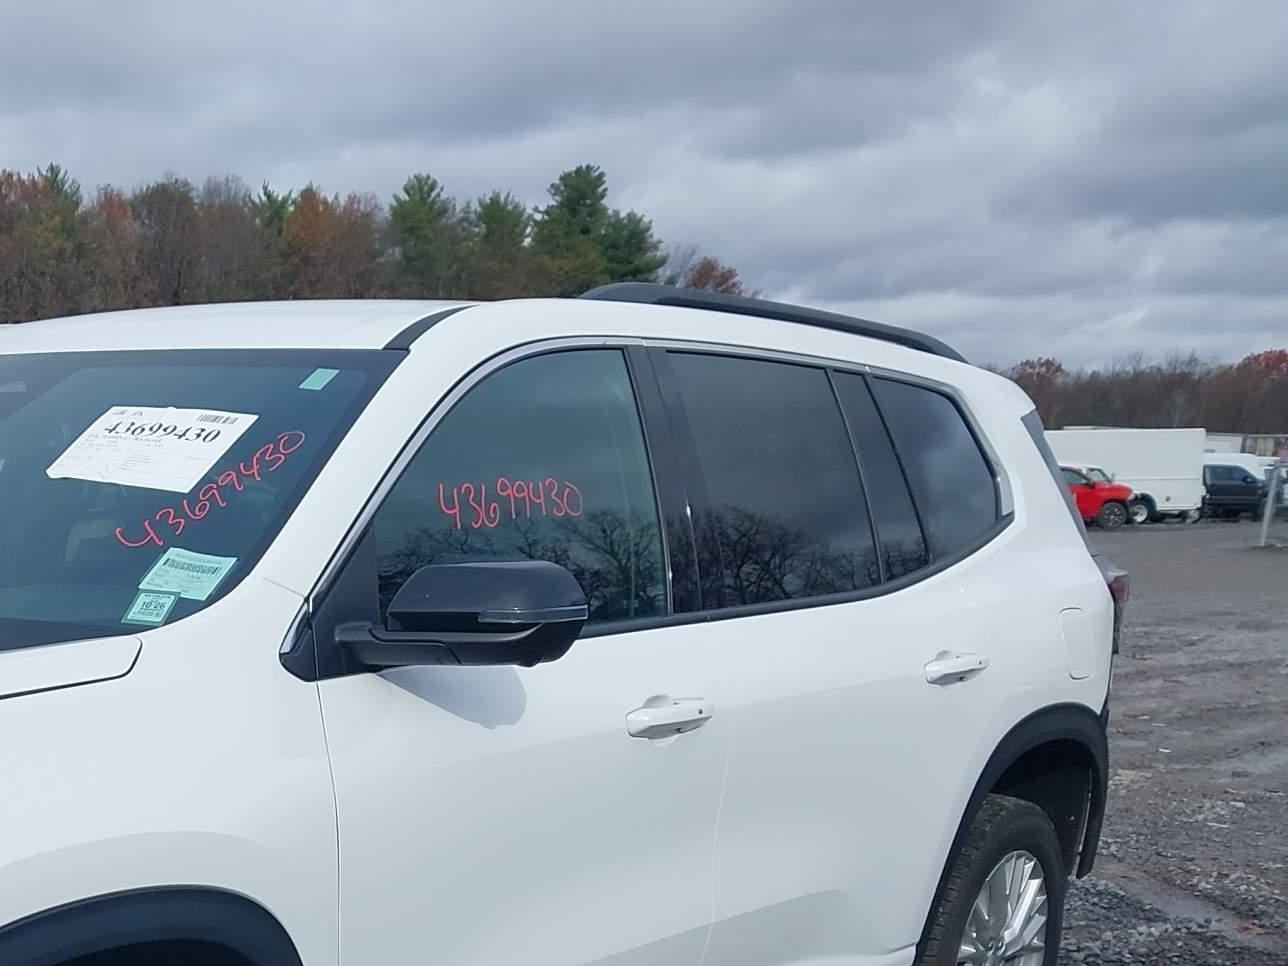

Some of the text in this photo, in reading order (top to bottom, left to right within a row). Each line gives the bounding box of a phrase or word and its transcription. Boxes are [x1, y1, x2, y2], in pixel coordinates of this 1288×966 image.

[104, 420, 221, 443] 43699430
[115, 431, 306, 548] 43699430
[438, 477, 583, 530] 43699430
